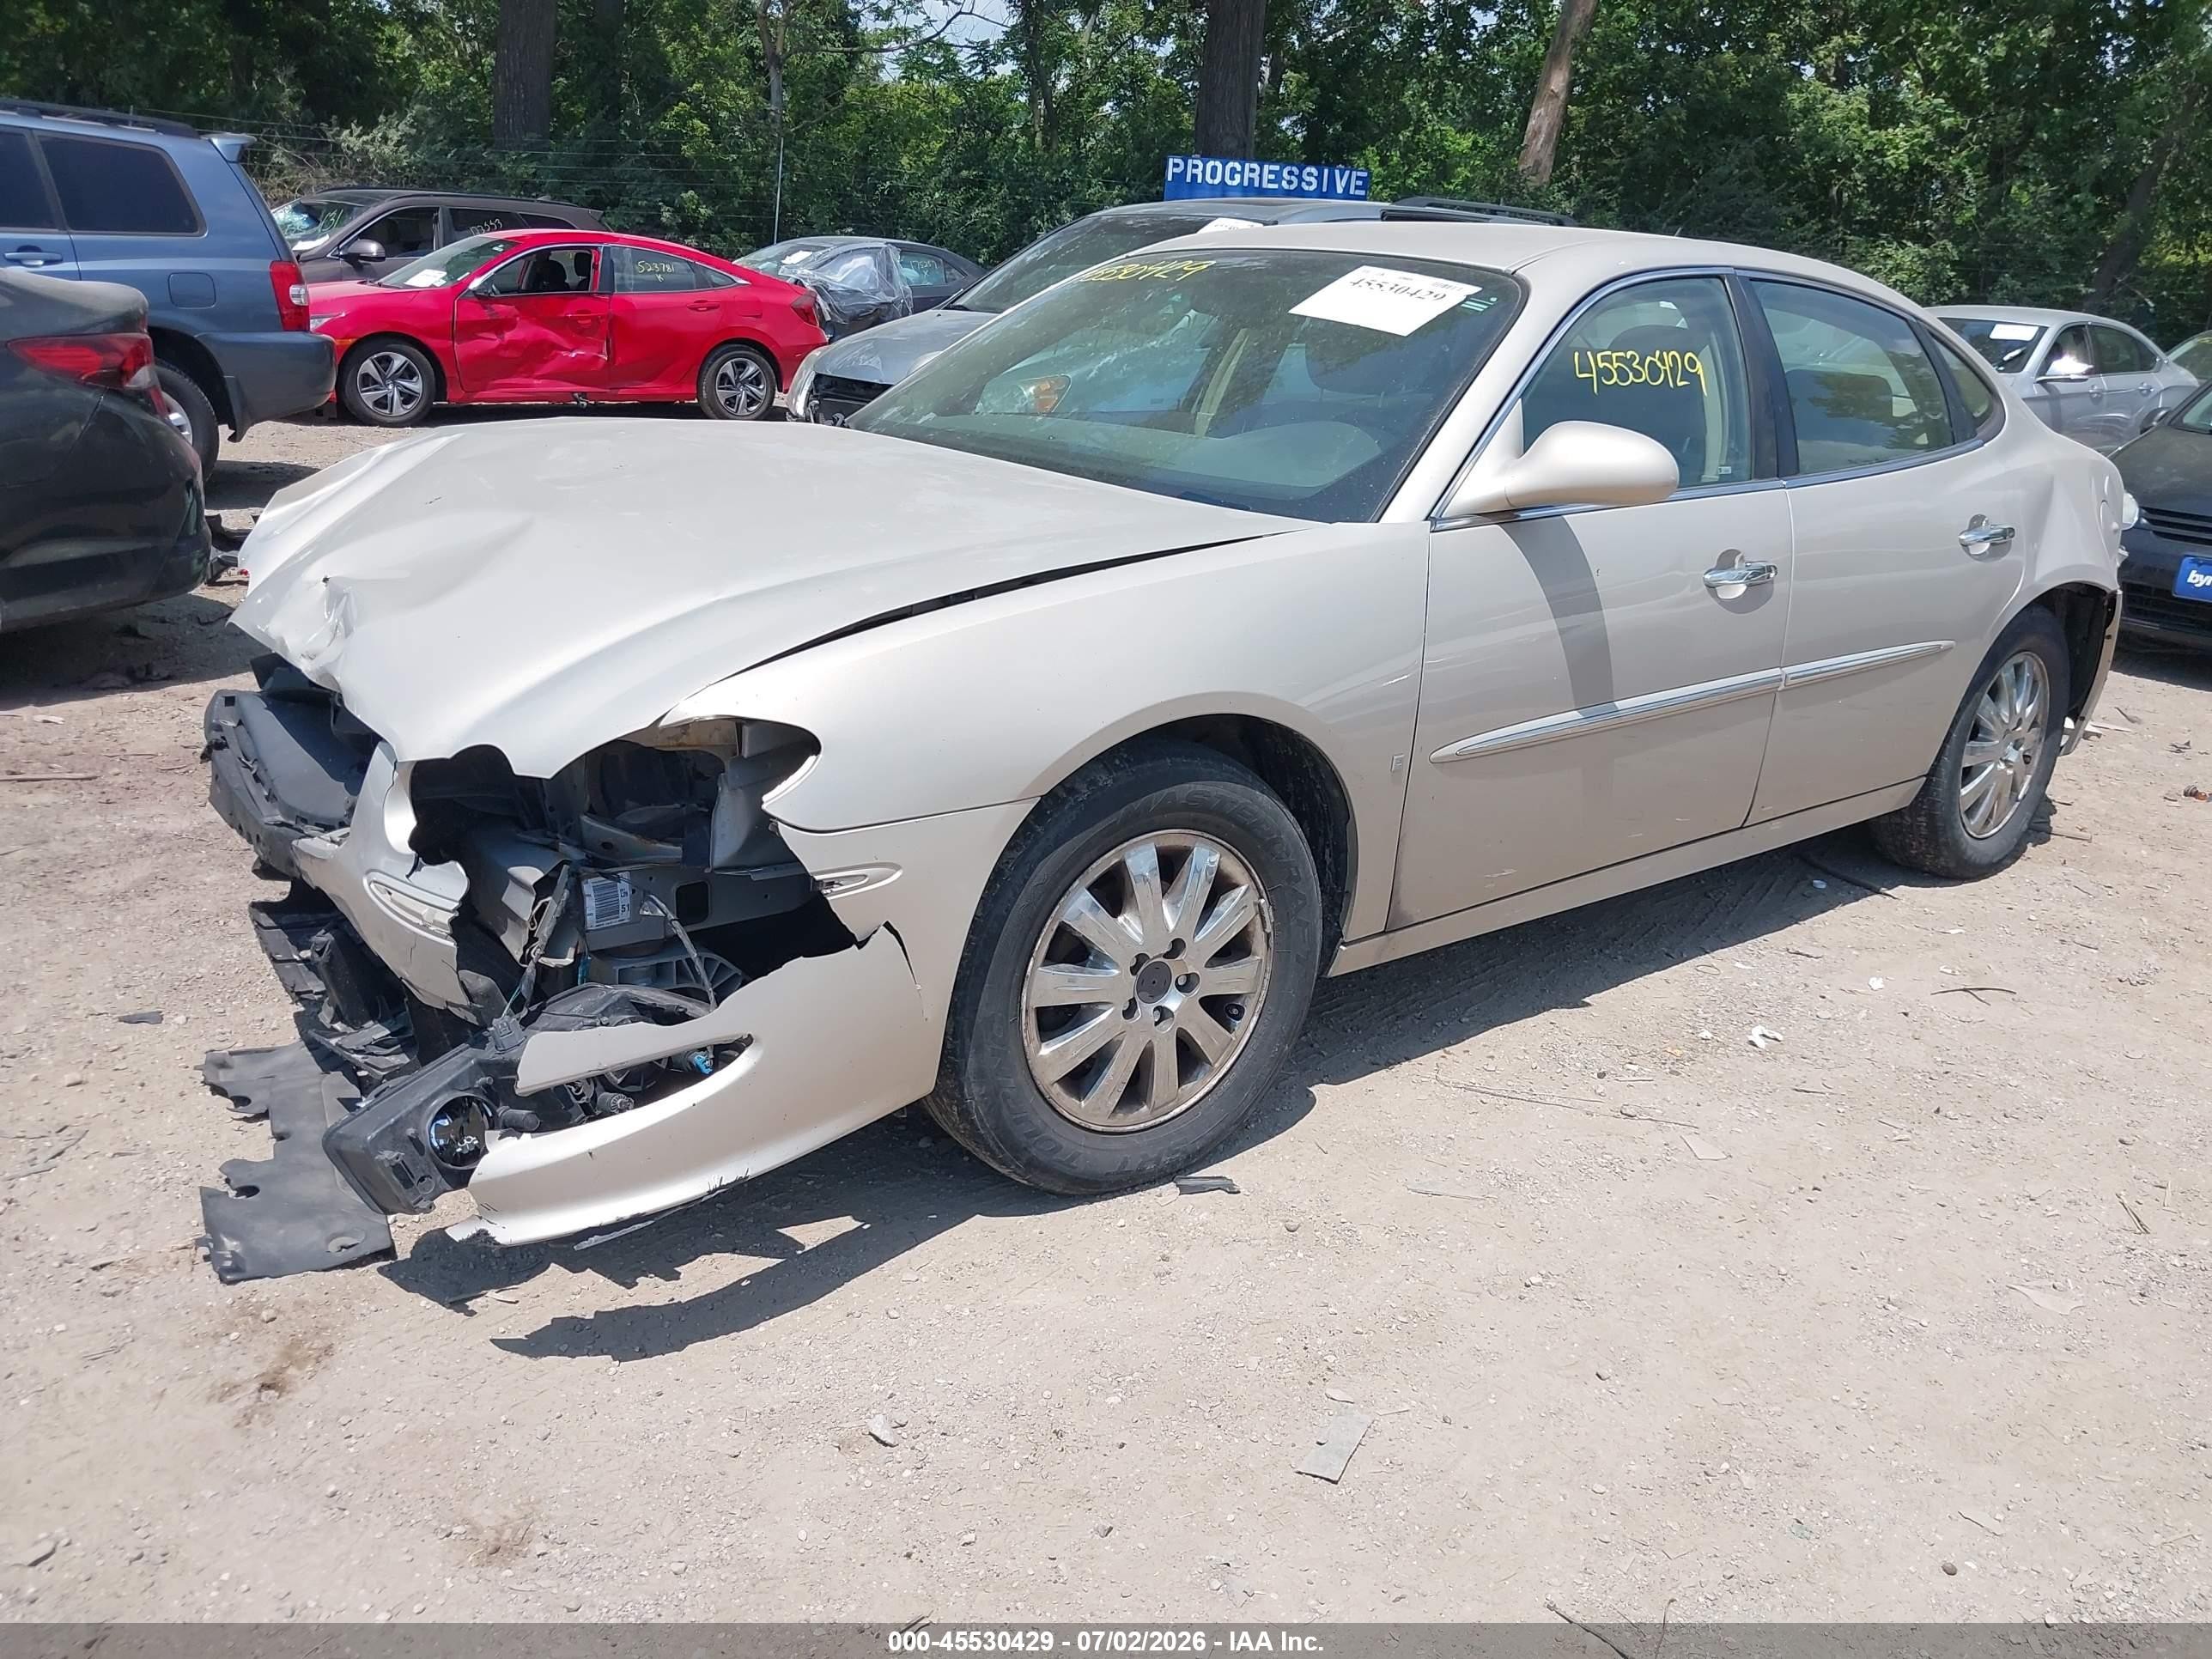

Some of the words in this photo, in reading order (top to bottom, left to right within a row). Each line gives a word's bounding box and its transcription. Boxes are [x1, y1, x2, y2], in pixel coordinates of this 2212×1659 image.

[1167, 157, 1368, 196] PROGRESSIVE
[637, 260, 675, 273] 523781
[1350, 278, 1447, 301] 45530429
[1574, 349, 1708, 398] 45530429
